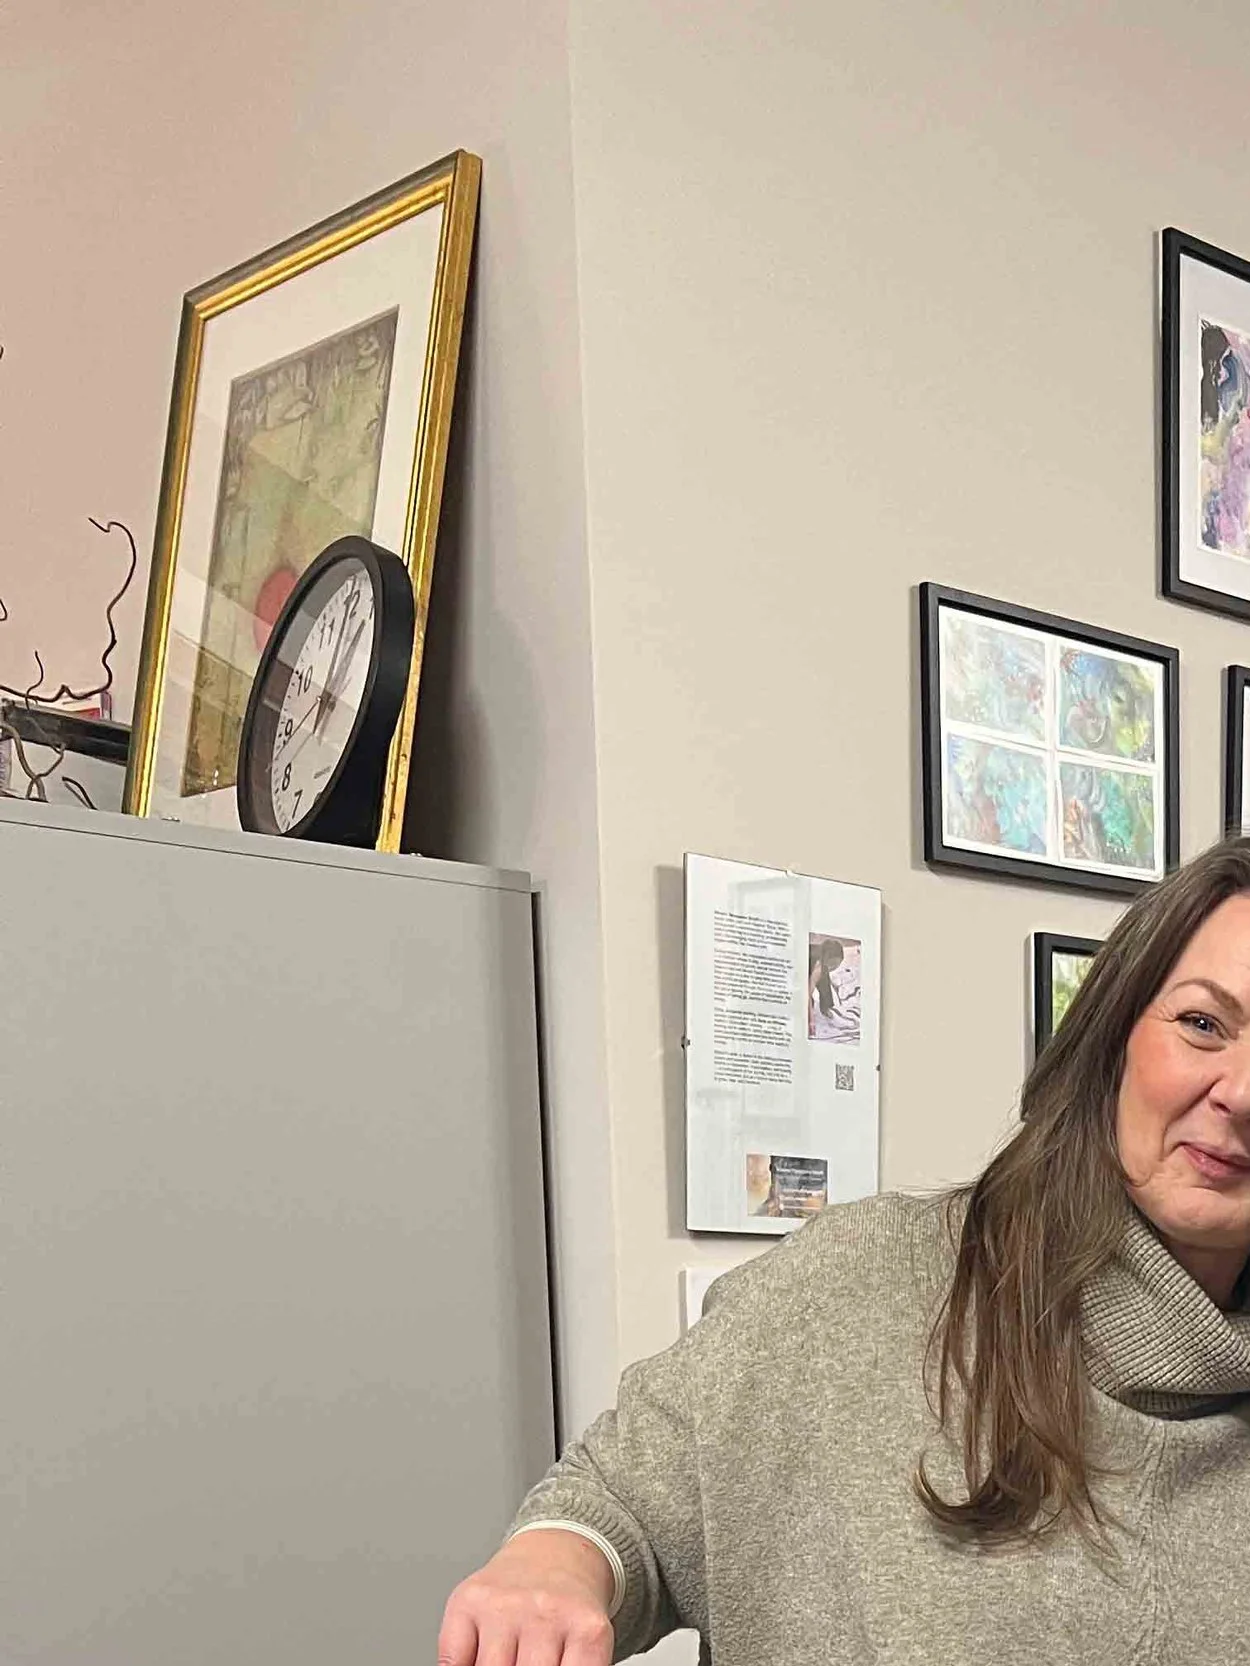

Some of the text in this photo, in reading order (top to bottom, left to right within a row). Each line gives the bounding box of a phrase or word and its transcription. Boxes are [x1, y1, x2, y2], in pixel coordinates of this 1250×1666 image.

[319, 617, 336, 649] 11
[297, 665, 313, 697] 10
[282, 762, 292, 791] 8
[291, 789, 303, 819] 7
